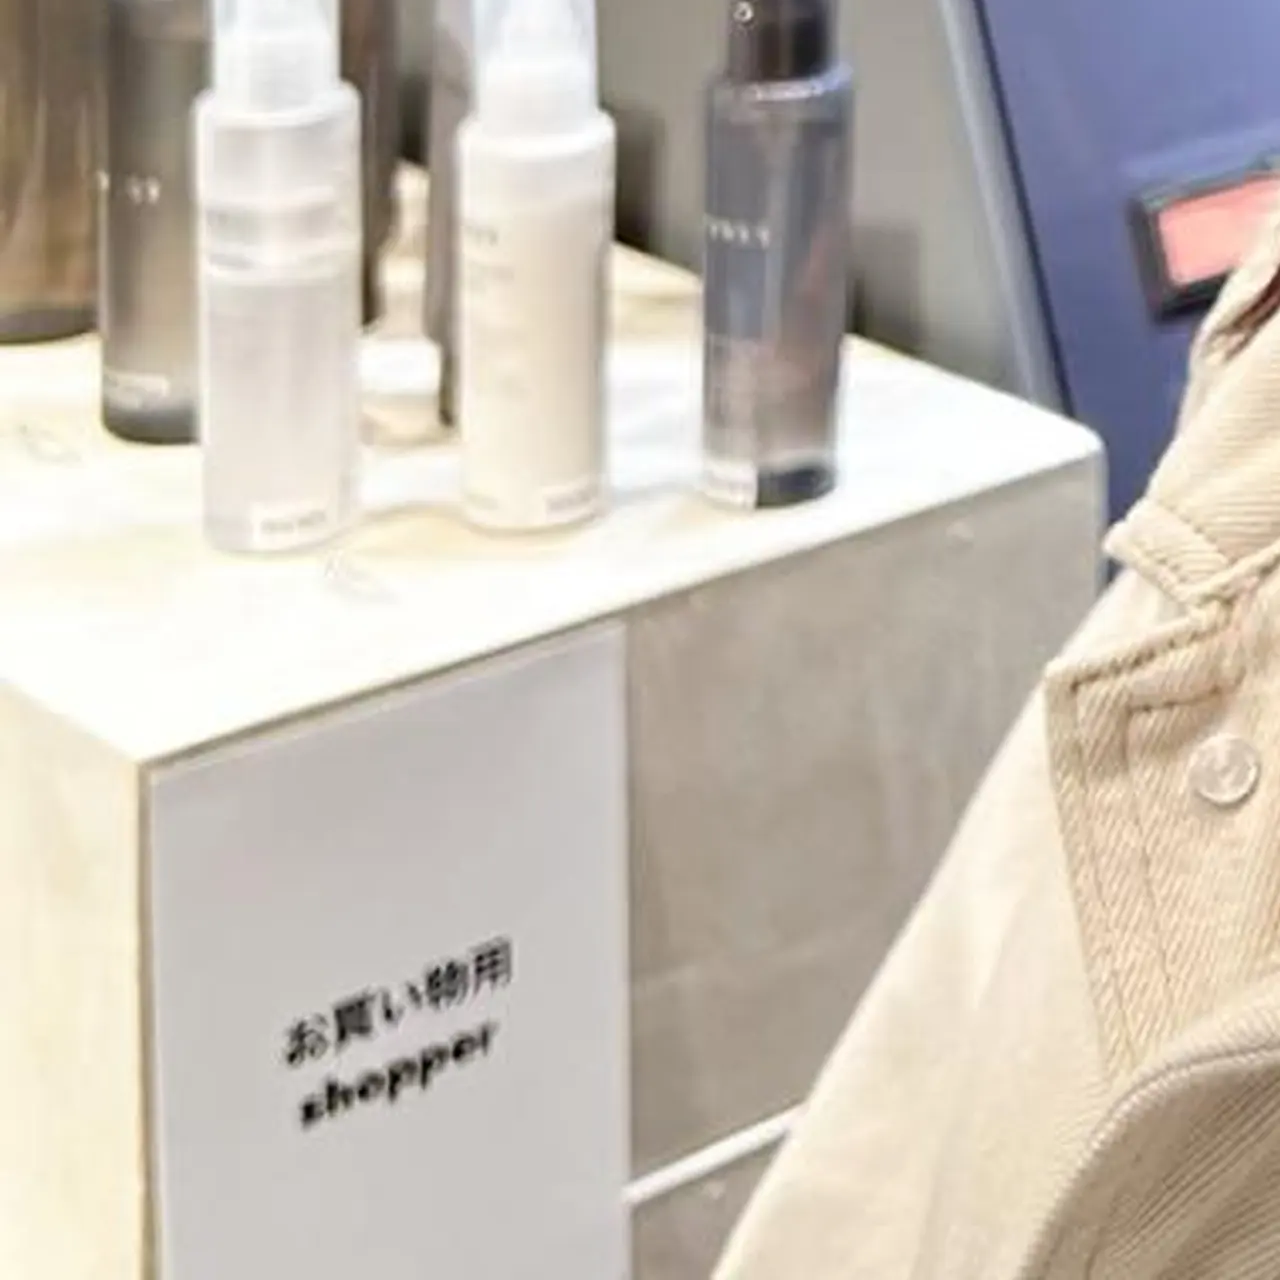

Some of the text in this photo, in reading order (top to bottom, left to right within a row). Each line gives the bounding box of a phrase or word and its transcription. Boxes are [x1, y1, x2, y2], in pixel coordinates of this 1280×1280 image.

[284, 935, 513, 1068] お買い物用
[300, 1020, 498, 1129] shopper
